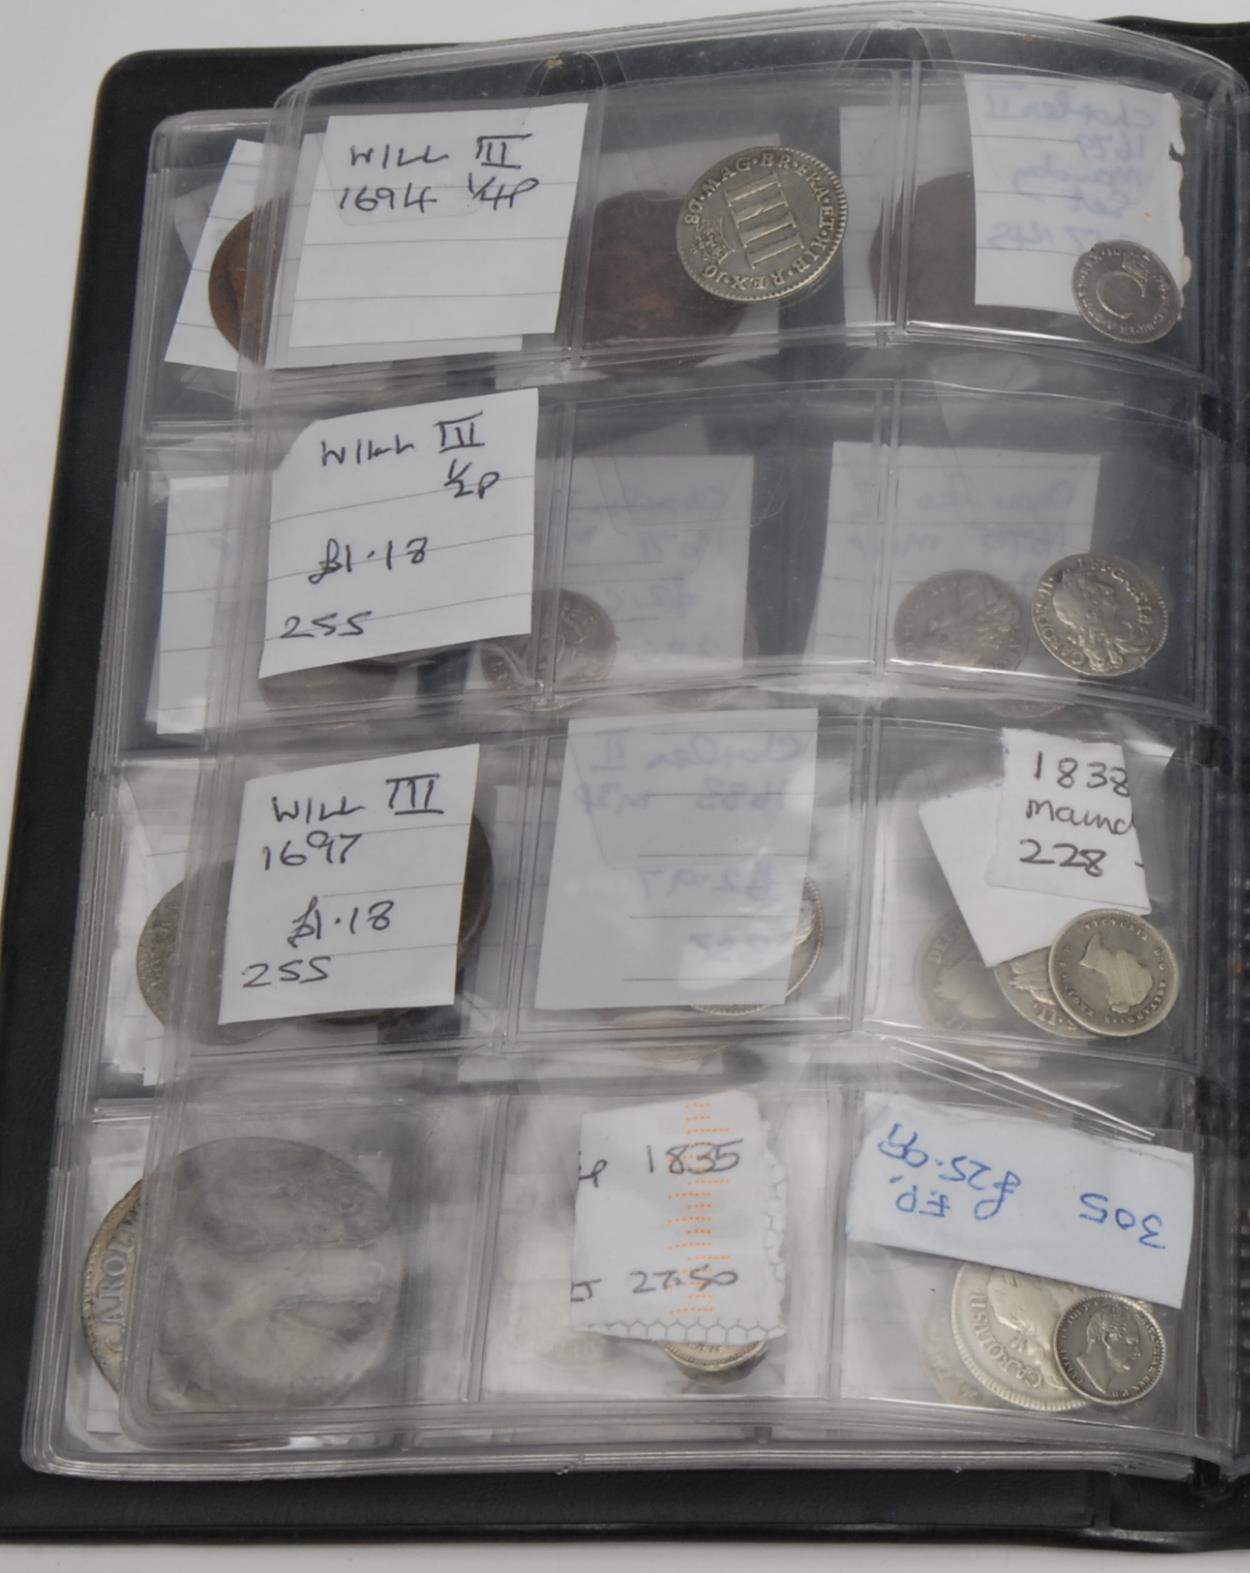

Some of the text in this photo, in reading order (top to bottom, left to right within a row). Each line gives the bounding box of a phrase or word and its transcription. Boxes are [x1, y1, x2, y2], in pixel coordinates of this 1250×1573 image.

[349, 132, 533, 169] WILL III
[338, 185, 438, 213] 1694
[320, 410, 486, 467] WILL III
[279, 610, 373, 639] 255
[1033, 750, 1131, 798] 1838
[270, 772, 445, 825] WILL III
[261, 829, 364, 872] 1697
[1018, 837, 1108, 878] 228
[241, 955, 332, 989] 255
[645, 1137, 745, 1176] 1835
[1079, 1191, 1167, 1251] 305
